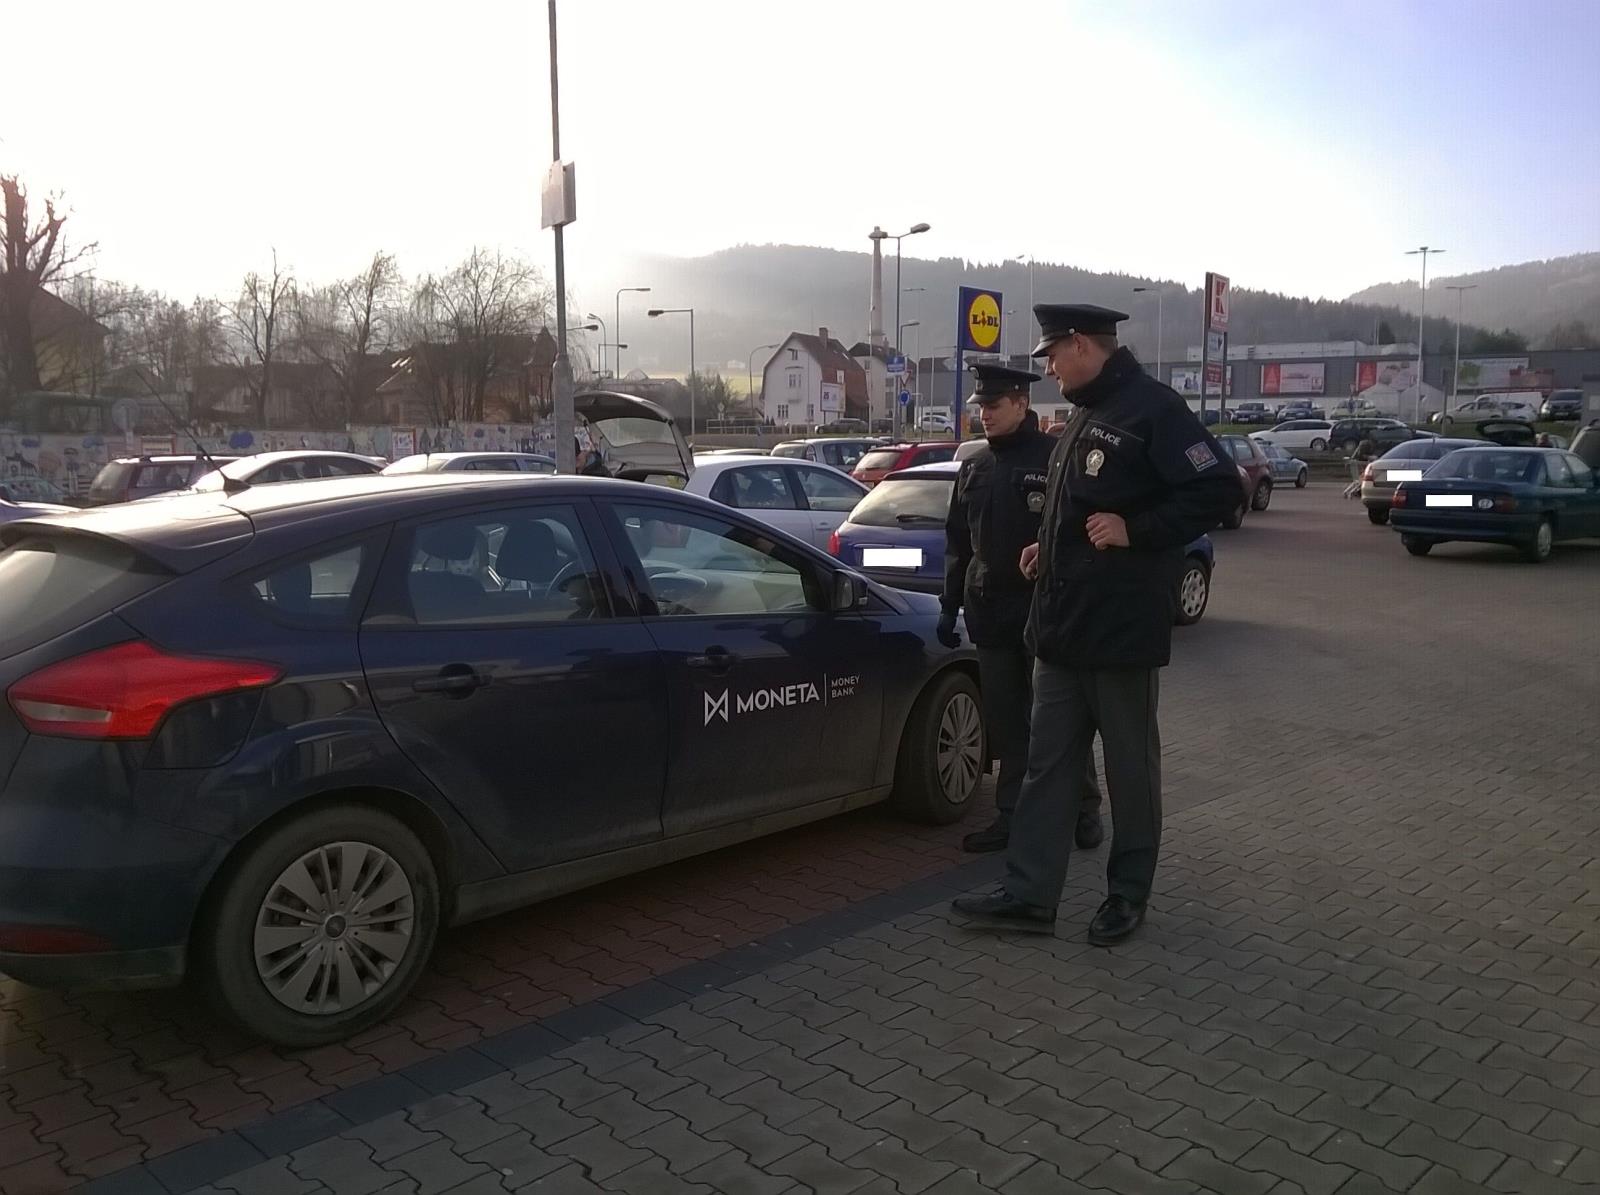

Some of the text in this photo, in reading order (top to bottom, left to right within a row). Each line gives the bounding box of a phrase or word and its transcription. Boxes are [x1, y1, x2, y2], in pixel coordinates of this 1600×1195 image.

[972, 310, 999, 327] LIDL
[1090, 427, 1122, 446] POLICE
[831, 675, 860, 688] MONEY
[737, 682, 820, 714] MONETA
[831, 687, 855, 698] BANK
